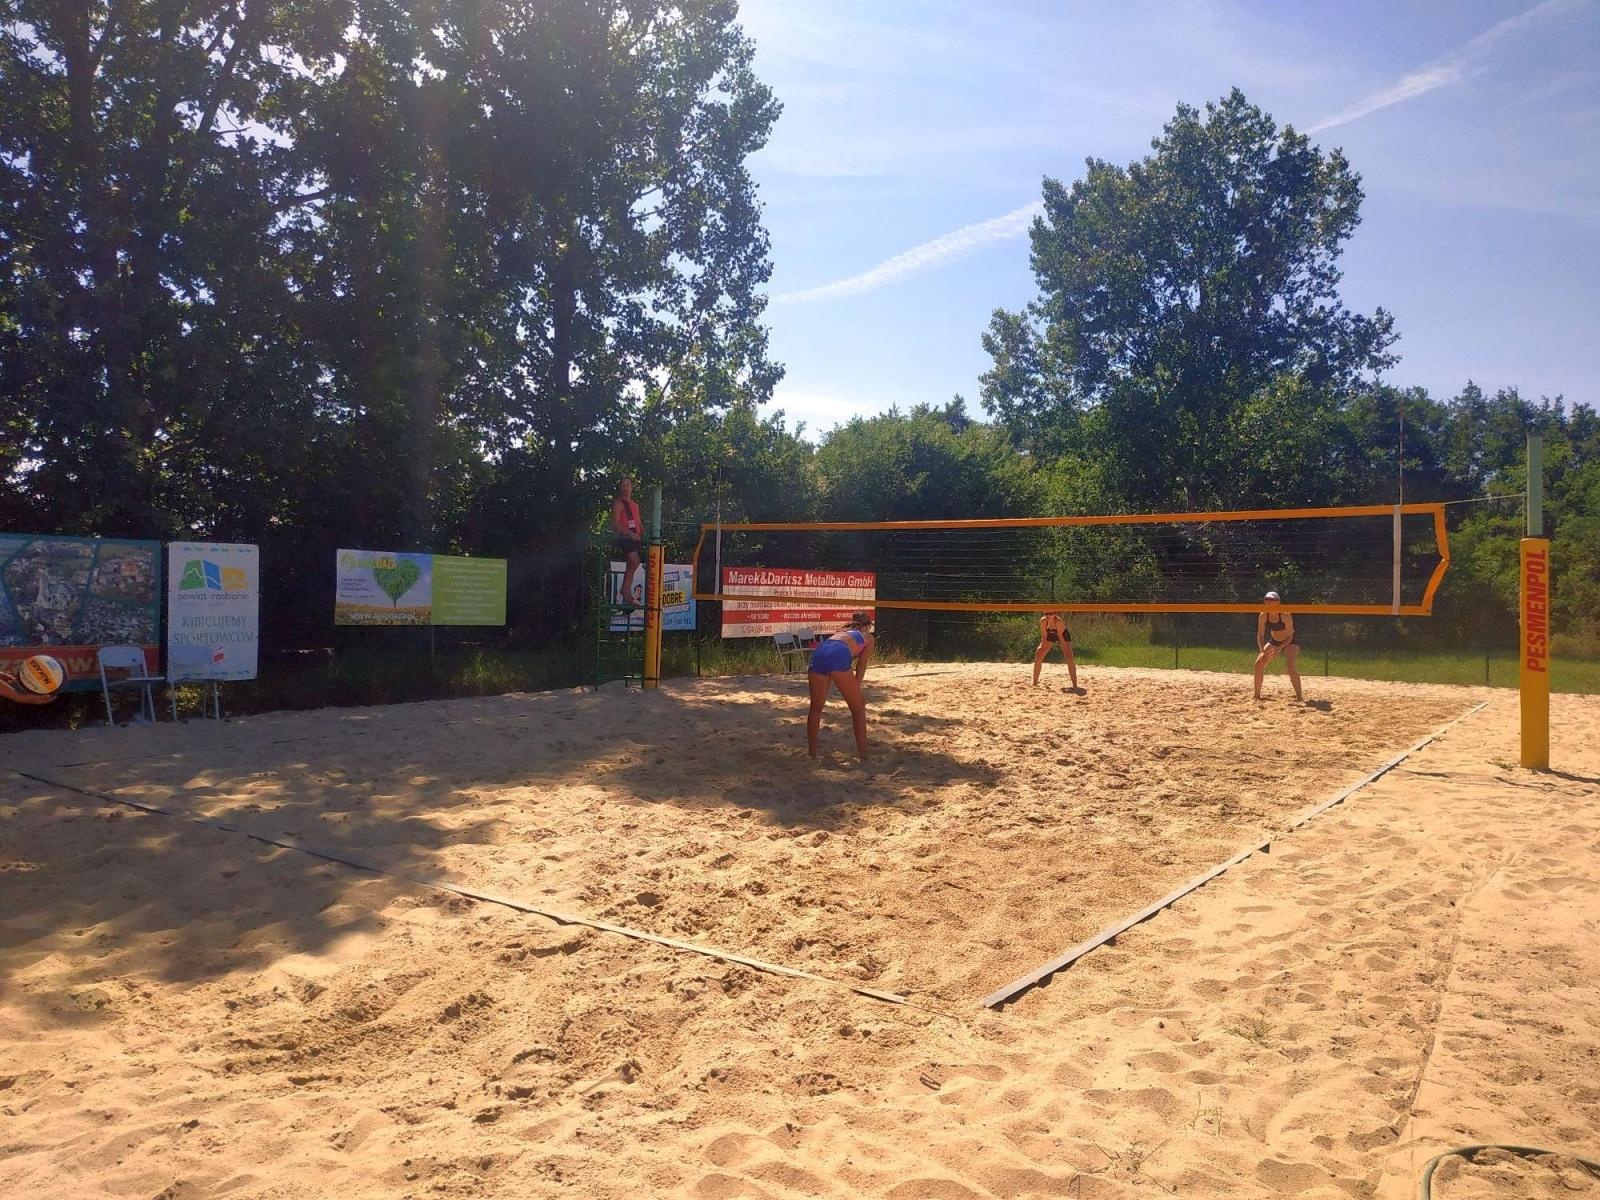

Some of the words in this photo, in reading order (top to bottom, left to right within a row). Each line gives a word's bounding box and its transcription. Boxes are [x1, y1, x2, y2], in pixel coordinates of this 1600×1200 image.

[804, 573, 846, 587] Metallbau
[847, 575, 874, 588] GmbH
[662, 592, 683, 605] DOBRE
[1526, 549, 1547, 673] PESMENPOL
[181, 615, 248, 629] KIBICUJEMY
